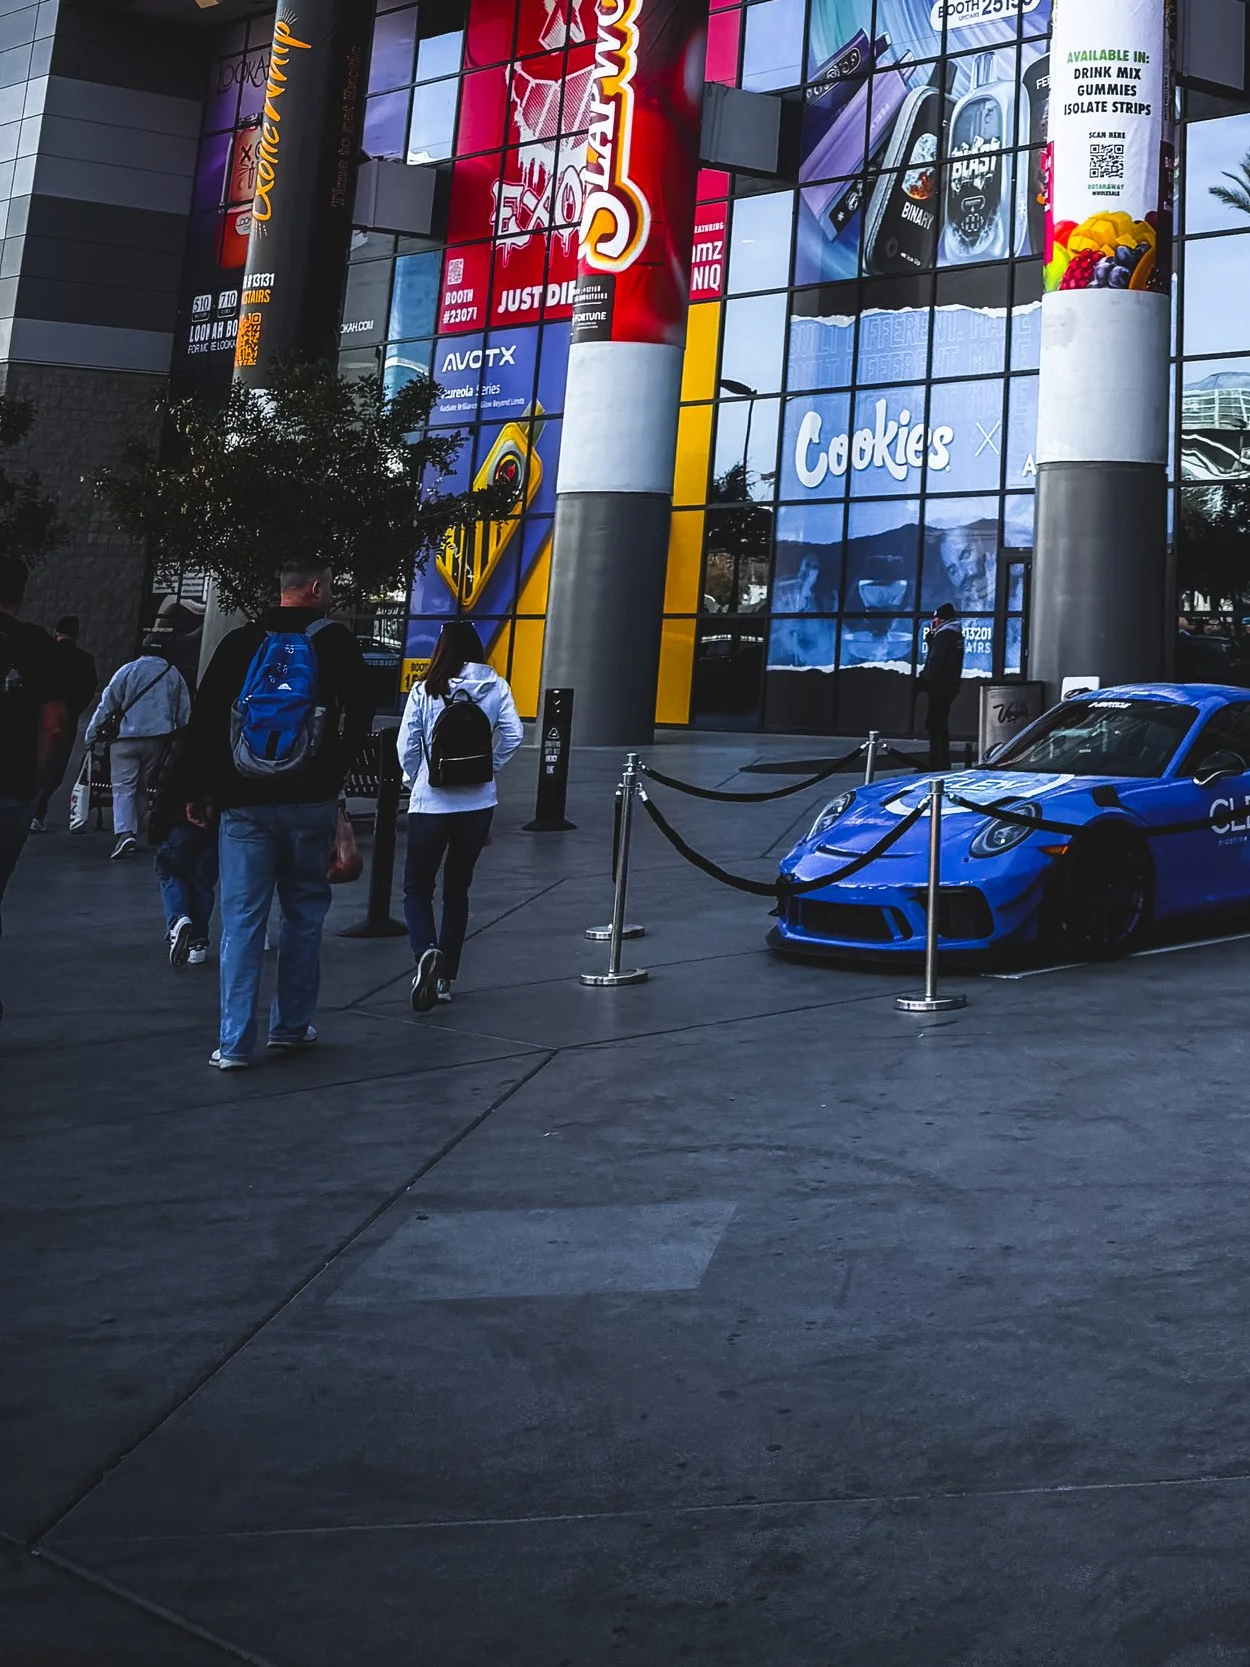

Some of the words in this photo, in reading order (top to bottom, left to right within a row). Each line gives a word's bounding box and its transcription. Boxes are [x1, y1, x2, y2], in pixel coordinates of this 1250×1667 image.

[1066, 49, 1129, 64] AVAILABLE
[1132, 50, 1151, 64] IN:
[1073, 67, 1112, 80] DRINK
[1116, 66, 1142, 80] MIX
[1077, 85, 1138, 97] GUMMIES
[1064, 102, 1109, 116] ISOLATE
[1111, 102, 1152, 116] STRIPS
[1088, 131, 1107, 139] SCAN
[901, 201, 935, 230] BINARY
[445, 288, 474, 306] BOOTH
[497, 283, 542, 314] JUST
[443, 307, 477, 325] #23071
[442, 344, 517, 373] AVOTX
[795, 397, 953, 488] Cookies
